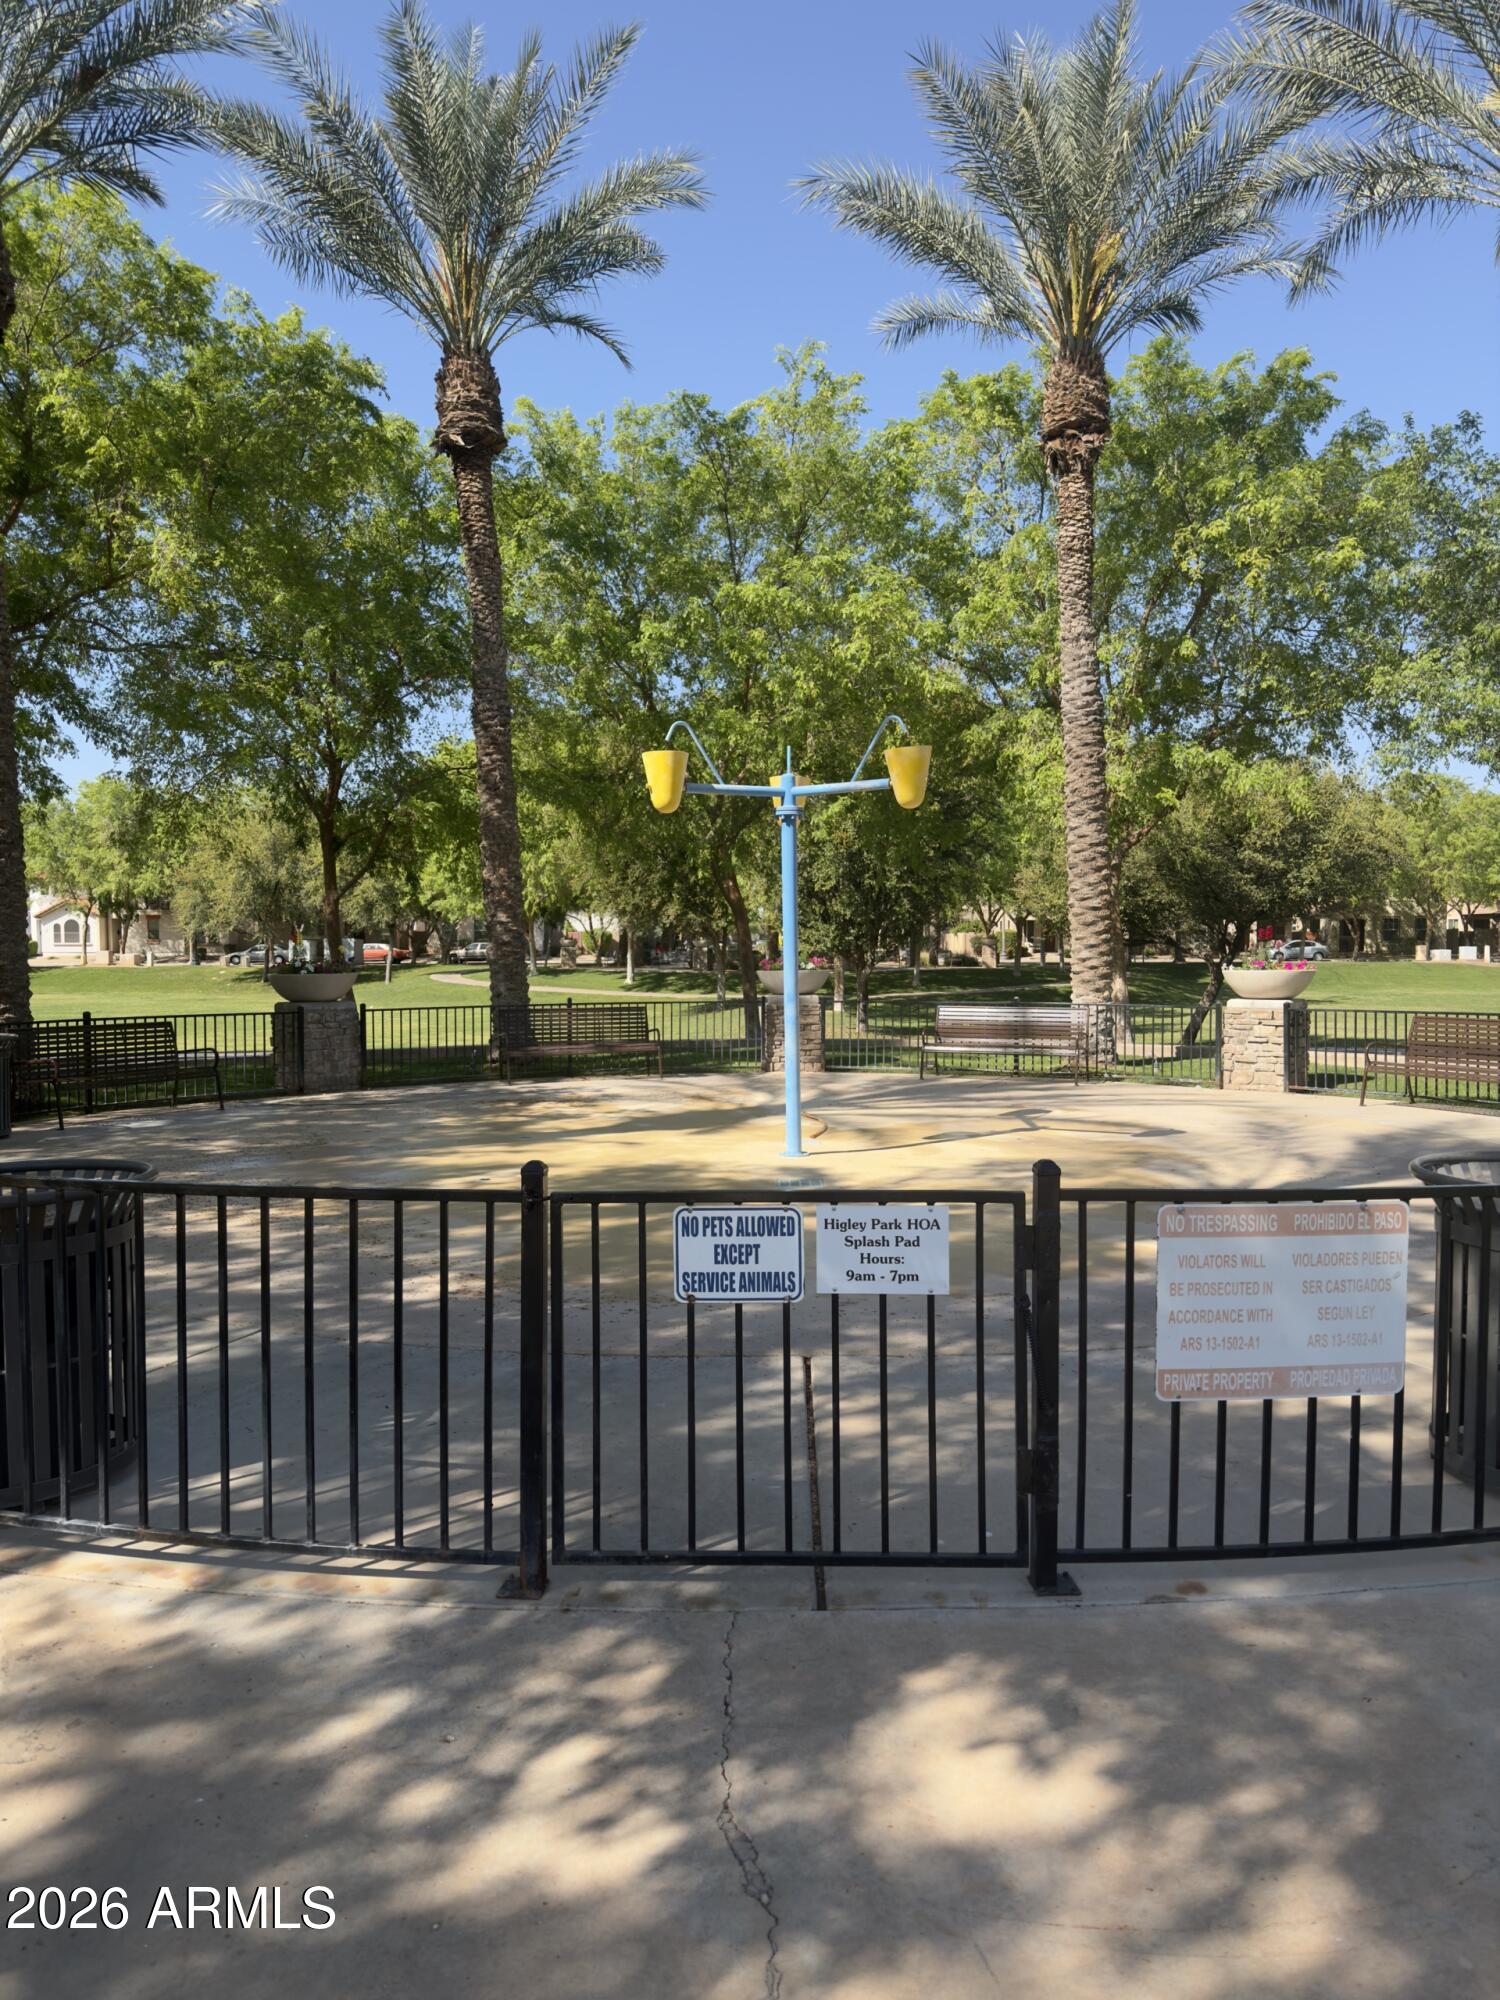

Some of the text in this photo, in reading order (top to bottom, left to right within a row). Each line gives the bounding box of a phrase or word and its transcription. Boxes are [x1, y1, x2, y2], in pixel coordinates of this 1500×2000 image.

[681, 1216, 795, 1237] NO PETS ALLOWED
[823, 1219, 940, 1232] Higley Park HOA
[1166, 1214, 1278, 1232] NO TRESPASSING
[1294, 1212, 1402, 1230] PROHIBIDO EL PASO
[844, 1236, 920, 1249] Splash Pad
[714, 1244, 760, 1265] EXCEPT
[860, 1253, 904, 1265] Hours:
[1178, 1254, 1266, 1268] VIOLATORS WILL
[1292, 1251, 1403, 1266] VIOLADORES PUEDEN
[682, 1271, 795, 1293] SERVICE ANIMALS
[846, 1270, 875, 1281] 9am
[891, 1270, 919, 1284] 7pm
[1170, 1282, 1273, 1296] BE PROSECUTED IN
[1302, 1278, 1392, 1294] SER CASTIGADOS
[1168, 1309, 1273, 1324] ACCORDANCE WITH
[1318, 1306, 1375, 1320] SEGUN LEY
[1180, 1336, 1260, 1350] ARS 13-1502-A1
[1307, 1332, 1383, 1348] ARS 13-1502-A1
[1164, 1372, 1274, 1391] PRIVATE PROPERTY
[1291, 1368, 1396, 1388] PROPIEDAD PRIVADA
